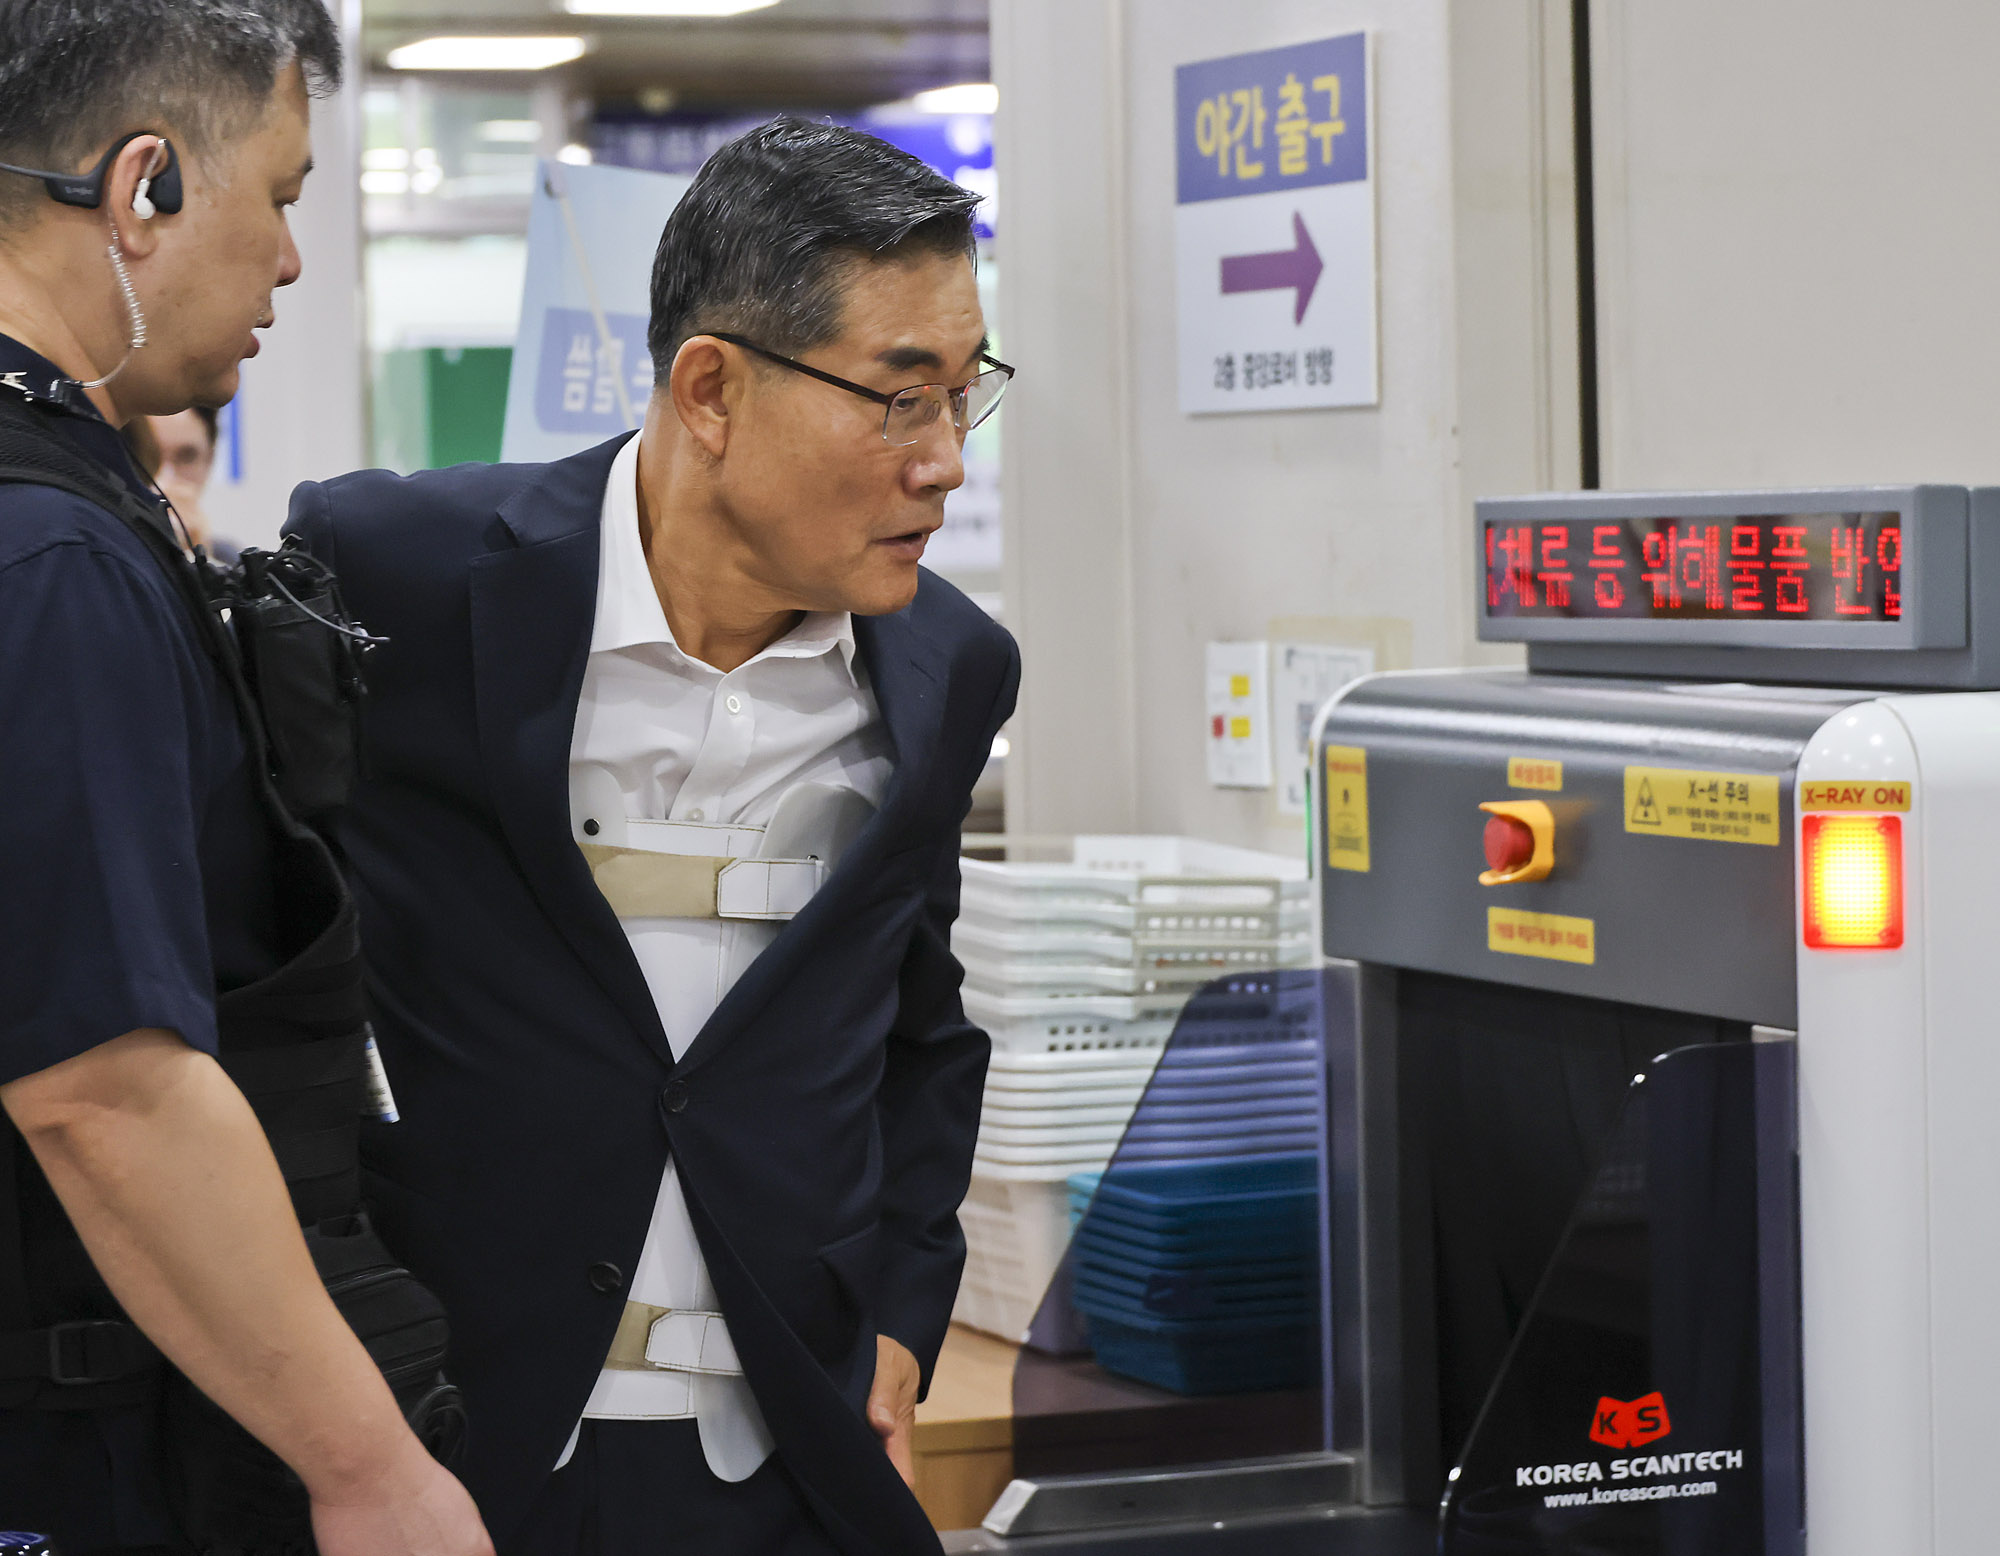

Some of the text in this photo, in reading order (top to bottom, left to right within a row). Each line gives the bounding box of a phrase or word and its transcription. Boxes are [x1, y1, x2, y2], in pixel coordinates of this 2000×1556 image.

[1195, 73, 1346, 180] 야간 출구
[1486, 526, 1574, 607] 체류
[1588, 525, 1626, 608] 등
[1641, 525, 1810, 613] 위해물품
[1724, 781, 1749, 806] 주의
[1805, 787, 1904, 805] X-RAY ON
[1516, 1449, 1743, 1487] KOREA SCANTECH
[1543, 1480, 1717, 1508] www.koreascan.com
